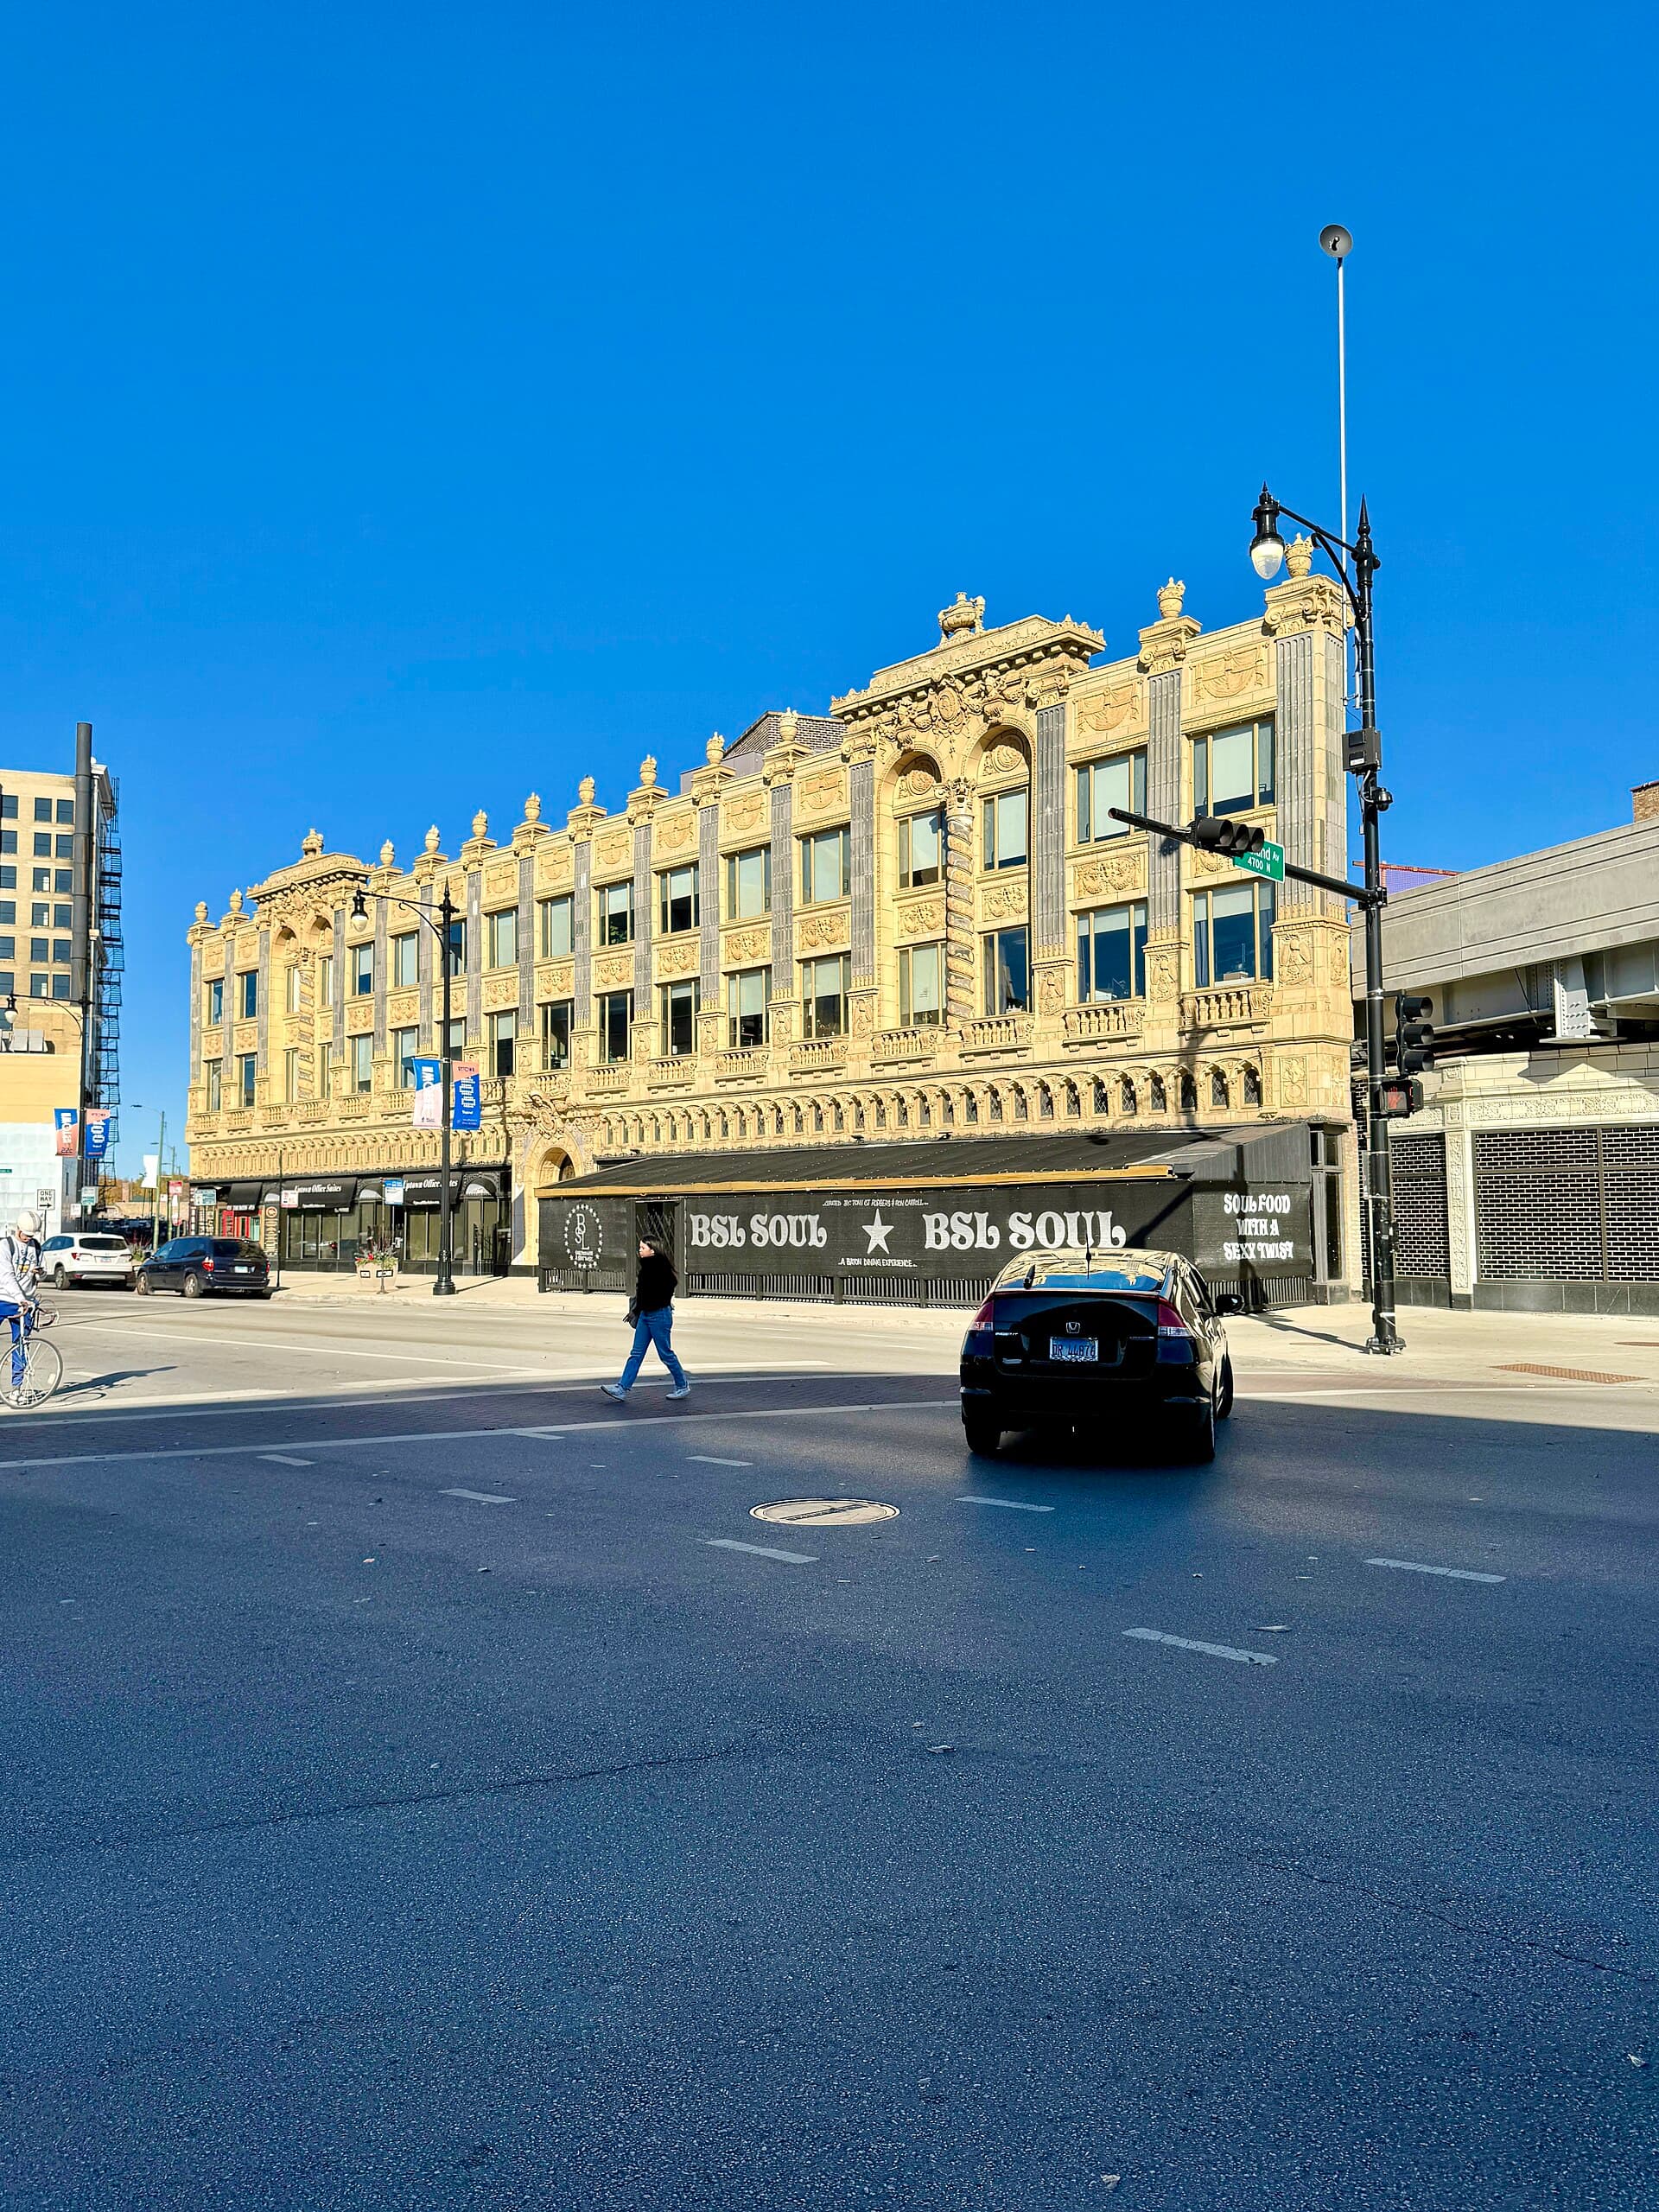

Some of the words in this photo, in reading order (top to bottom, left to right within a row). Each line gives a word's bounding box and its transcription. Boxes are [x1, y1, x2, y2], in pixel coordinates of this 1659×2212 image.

[1247, 856, 1264, 870] 4700
[1266, 861, 1271, 874] N
[1272, 851, 1280, 863] Av
[312, 1184, 327, 1193] Office
[326, 1183, 342, 1192] Suites
[423, 1179, 439, 1188] Office
[1224, 1193, 1257, 1214] SOUL
[1258, 1194, 1291, 1214] FOOD
[690, 1214, 746, 1248] BSL
[750, 1213, 828, 1248] SOUL
[922, 1211, 1001, 1250] BSL
[1008, 1211, 1127, 1249] SOUL
[1236, 1218, 1268, 1236] WITH
[1269, 1218, 1280, 1236] A
[1223, 1242, 1256, 1261] SEXY
[1256, 1241, 1294, 1260] TWIST
[1052, 1344, 1064, 1357] DR
